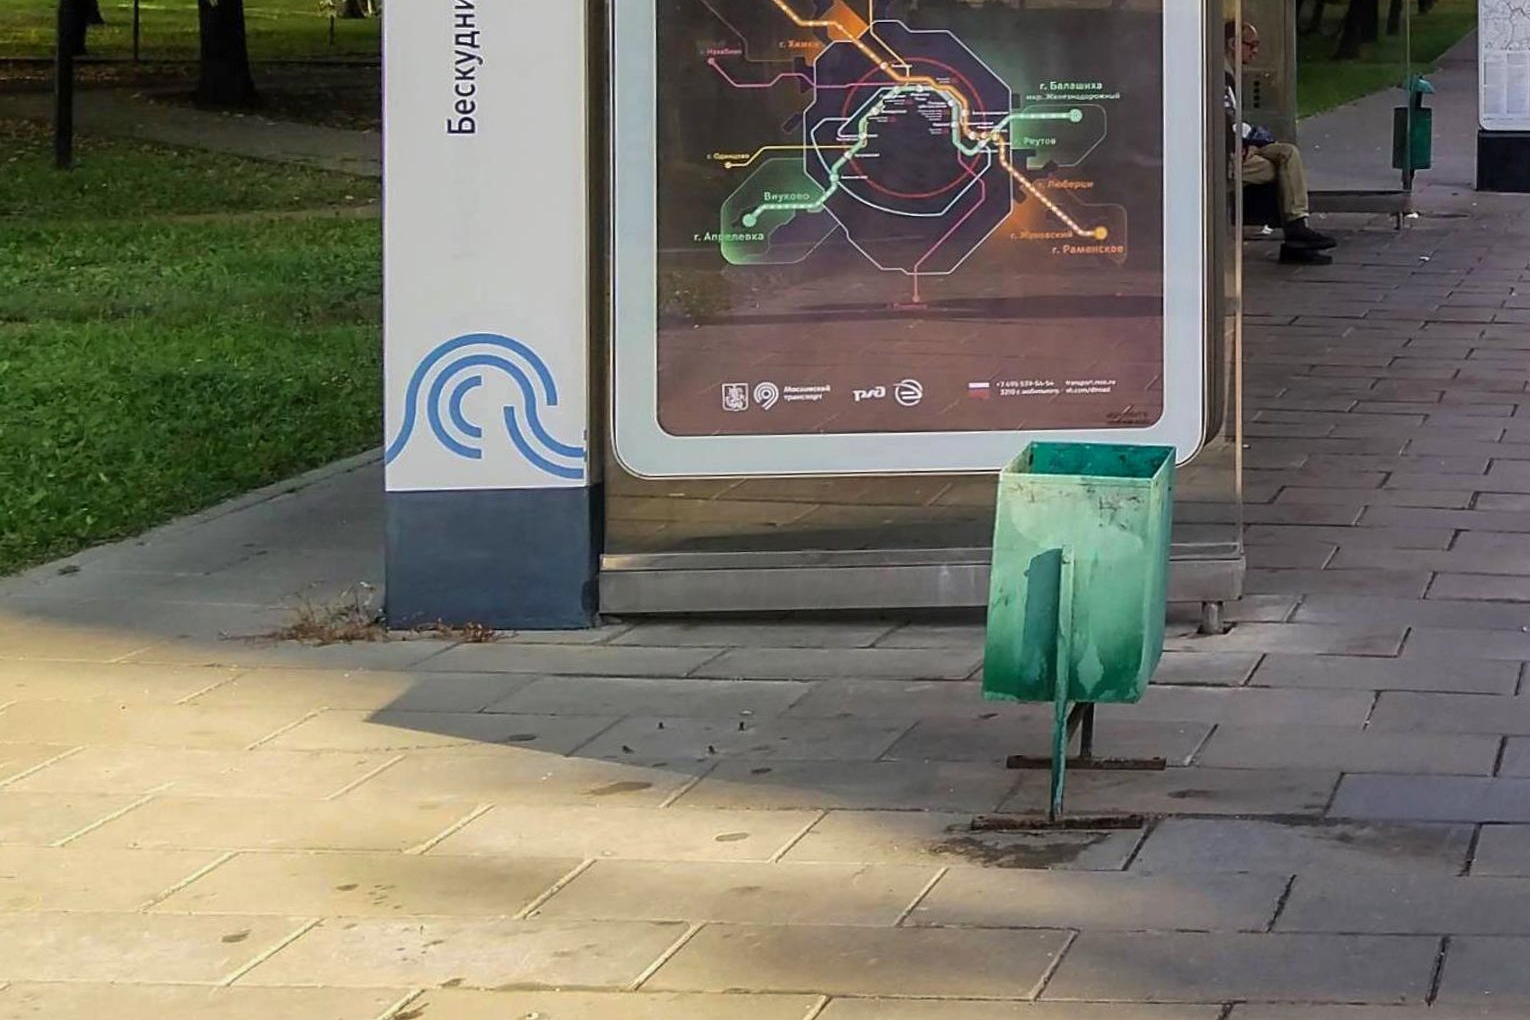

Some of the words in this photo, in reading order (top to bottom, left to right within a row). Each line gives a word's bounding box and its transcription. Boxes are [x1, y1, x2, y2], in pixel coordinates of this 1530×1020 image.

[1050, 81, 1103, 90] Балашиха
[763, 191, 810, 202] Внуково
[704, 231, 765, 243] Апрелевка
[1062, 244, 1124, 254] Раменское
